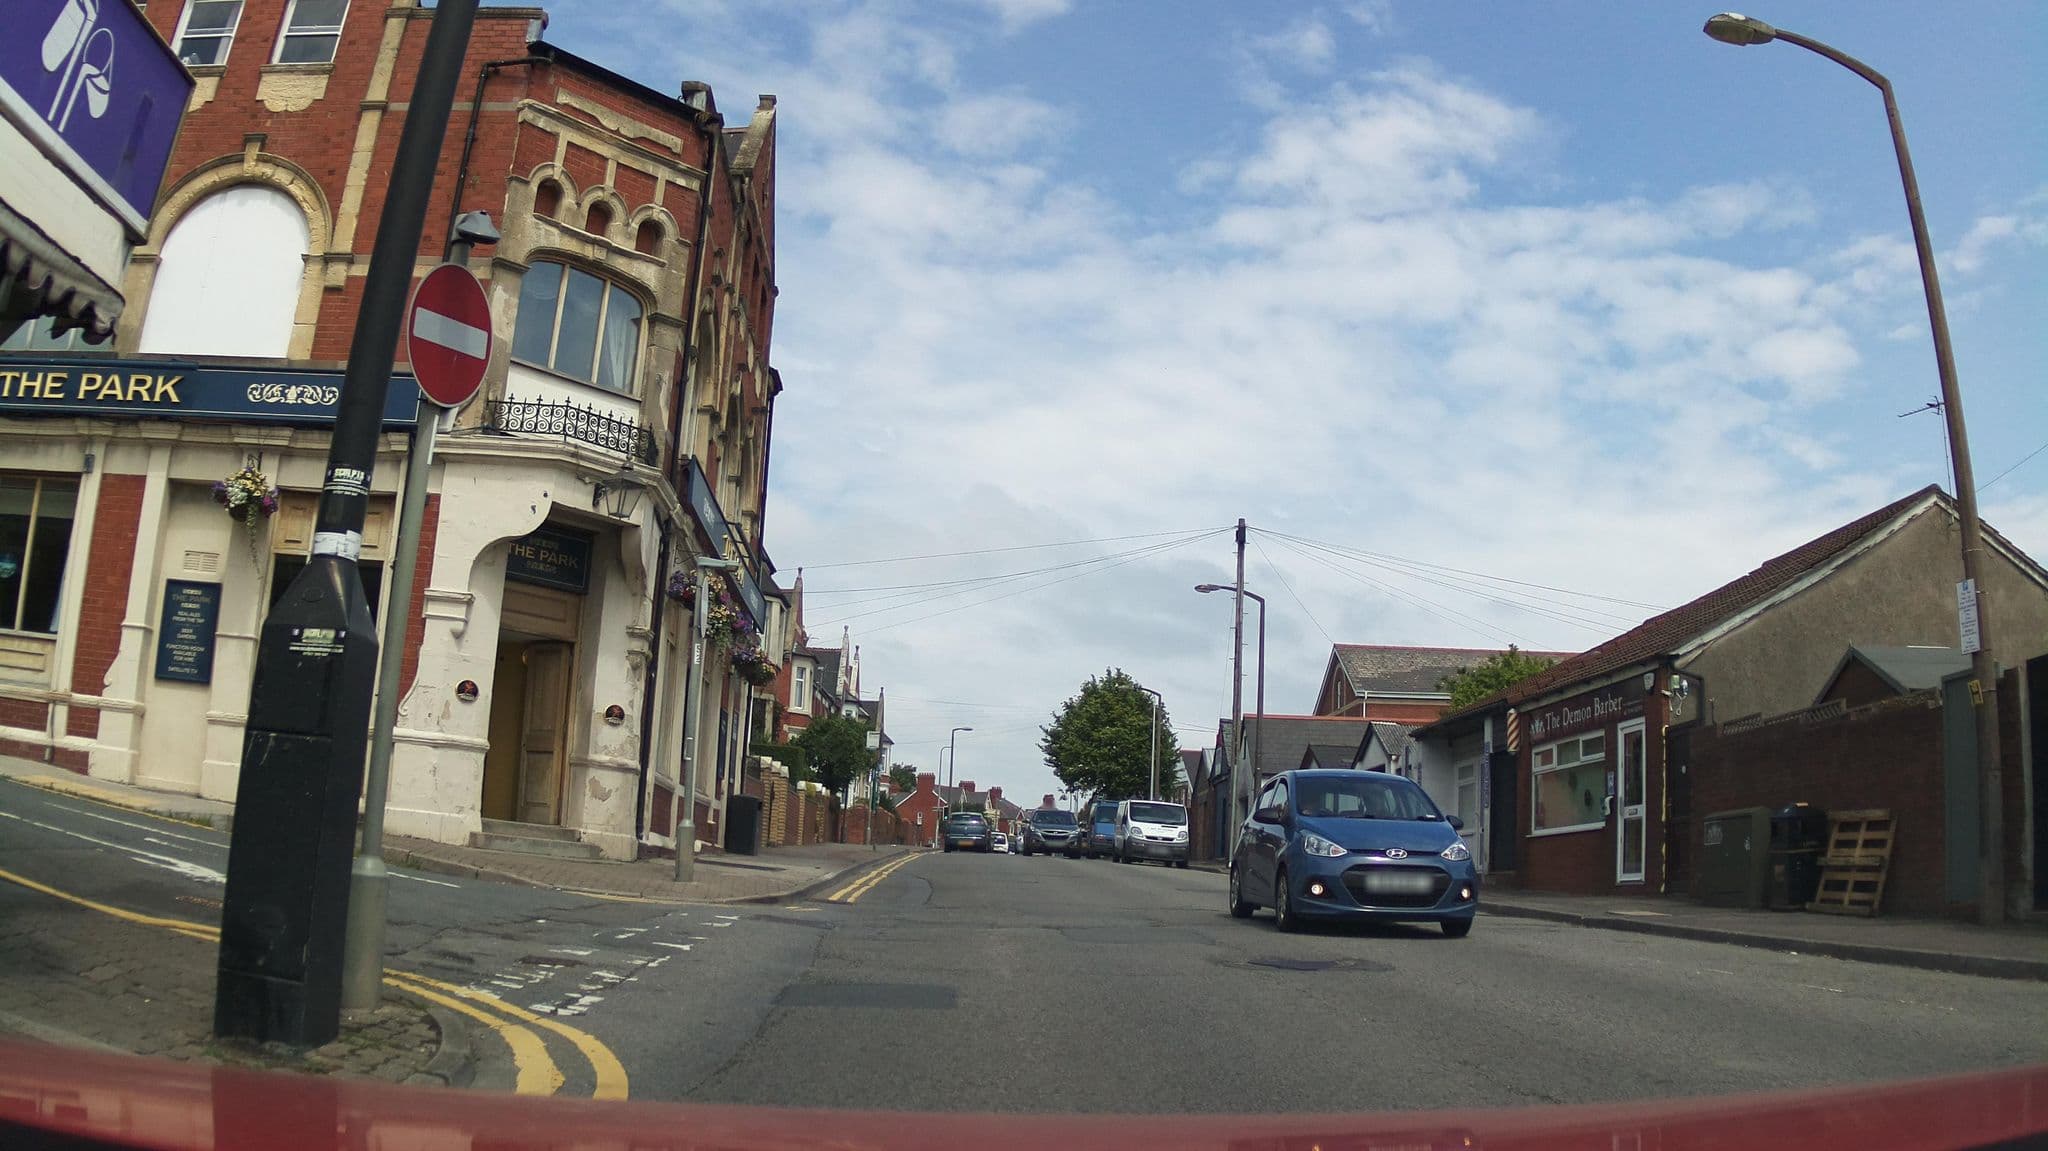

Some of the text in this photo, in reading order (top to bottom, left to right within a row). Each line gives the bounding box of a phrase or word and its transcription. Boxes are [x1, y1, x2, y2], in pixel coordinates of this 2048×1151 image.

[0, 371, 184, 403] THE PARK
[507, 543, 578, 568] THE PARK
[1545, 711, 1560, 731] The
[1562, 706, 1592, 726] Demon
[1594, 693, 1623, 717] Barber
